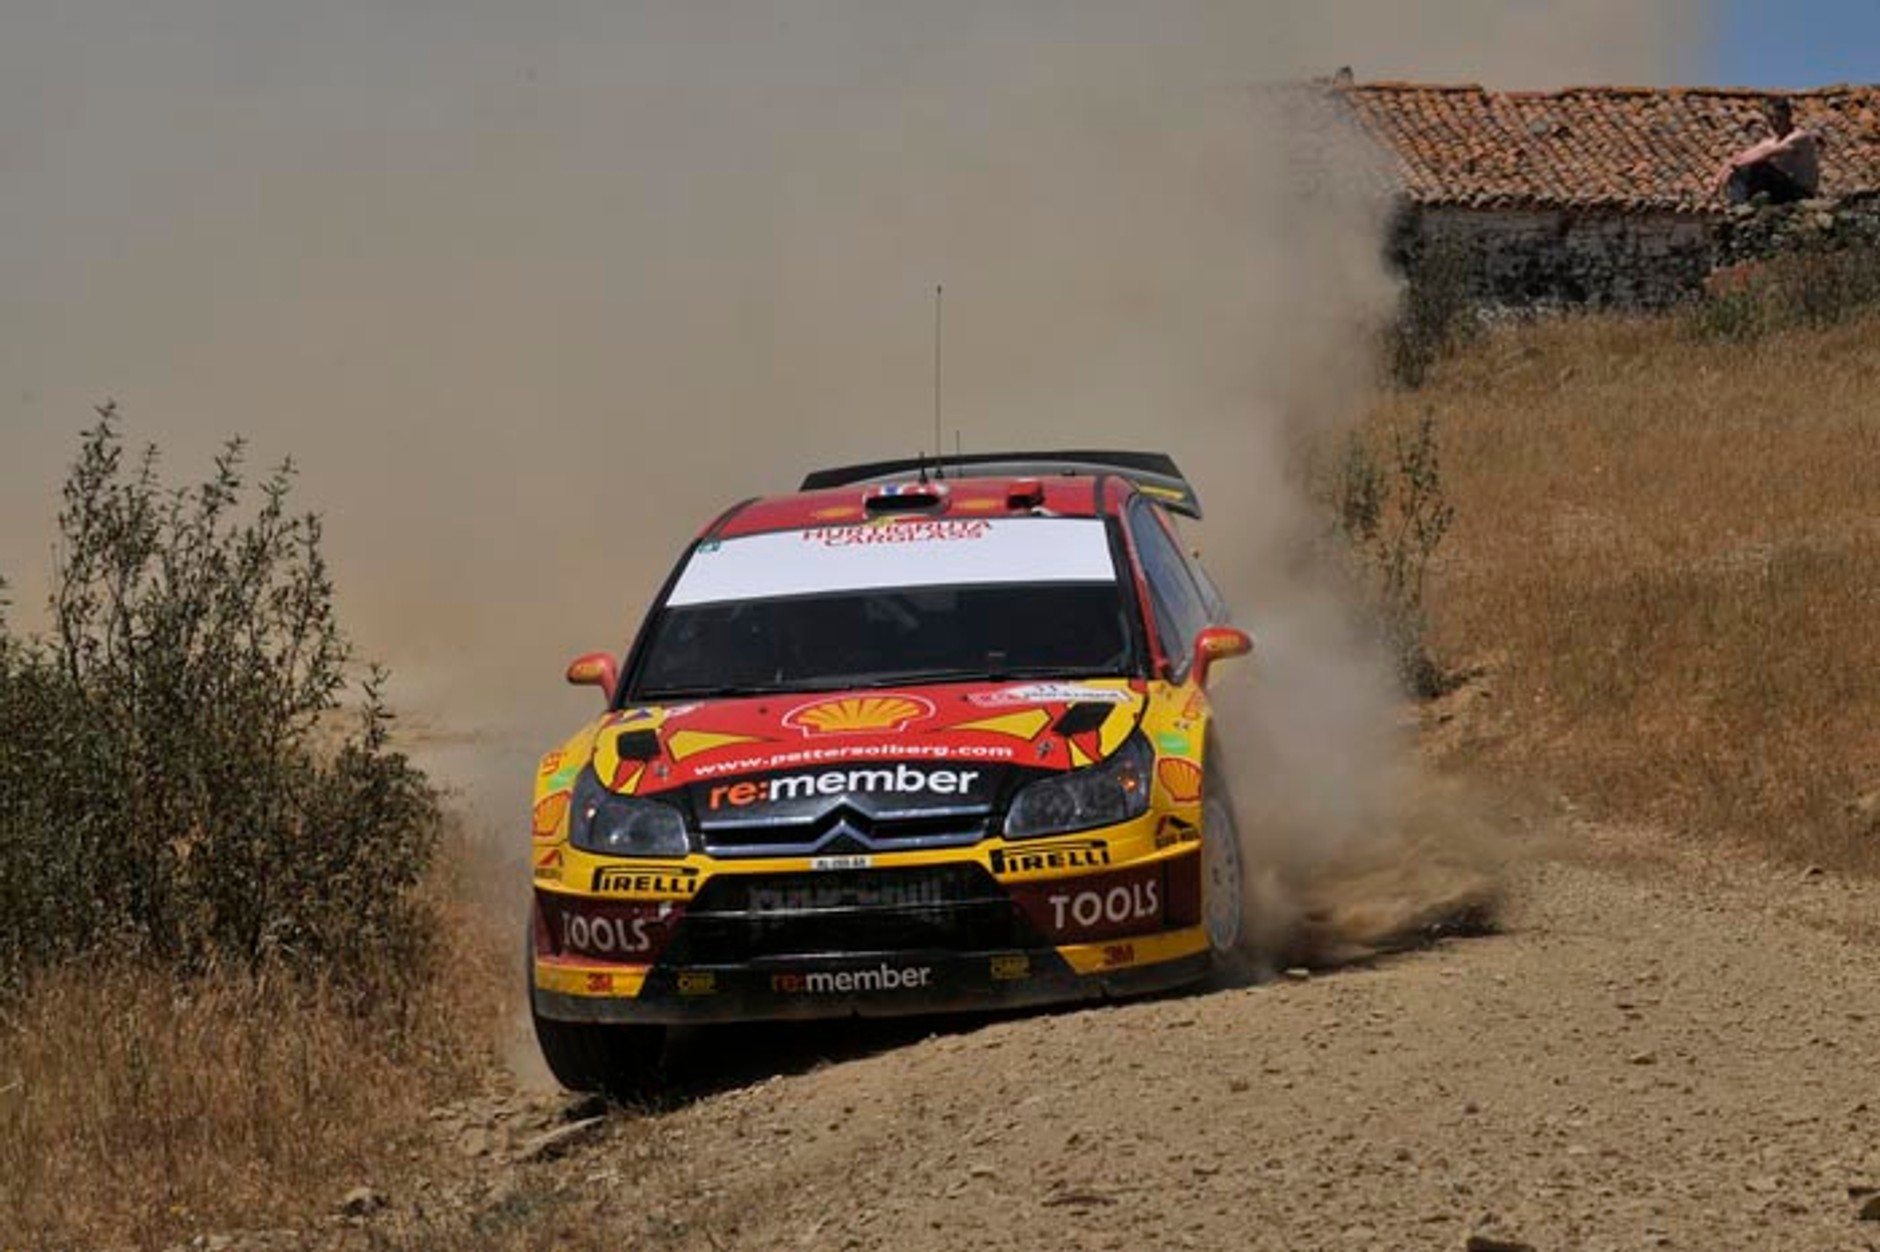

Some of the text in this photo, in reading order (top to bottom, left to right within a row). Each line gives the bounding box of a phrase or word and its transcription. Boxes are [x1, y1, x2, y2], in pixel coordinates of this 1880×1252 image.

[694, 744, 1013, 776] www.pettersolberg.com
[709, 763, 980, 810] re:member
[990, 839, 1111, 874] PIRELLI
[591, 864, 700, 893] PIRELLI
[1049, 880, 1159, 930] TOOLS
[561, 911, 650, 951] TOOLS
[772, 962, 933, 993] re:member
